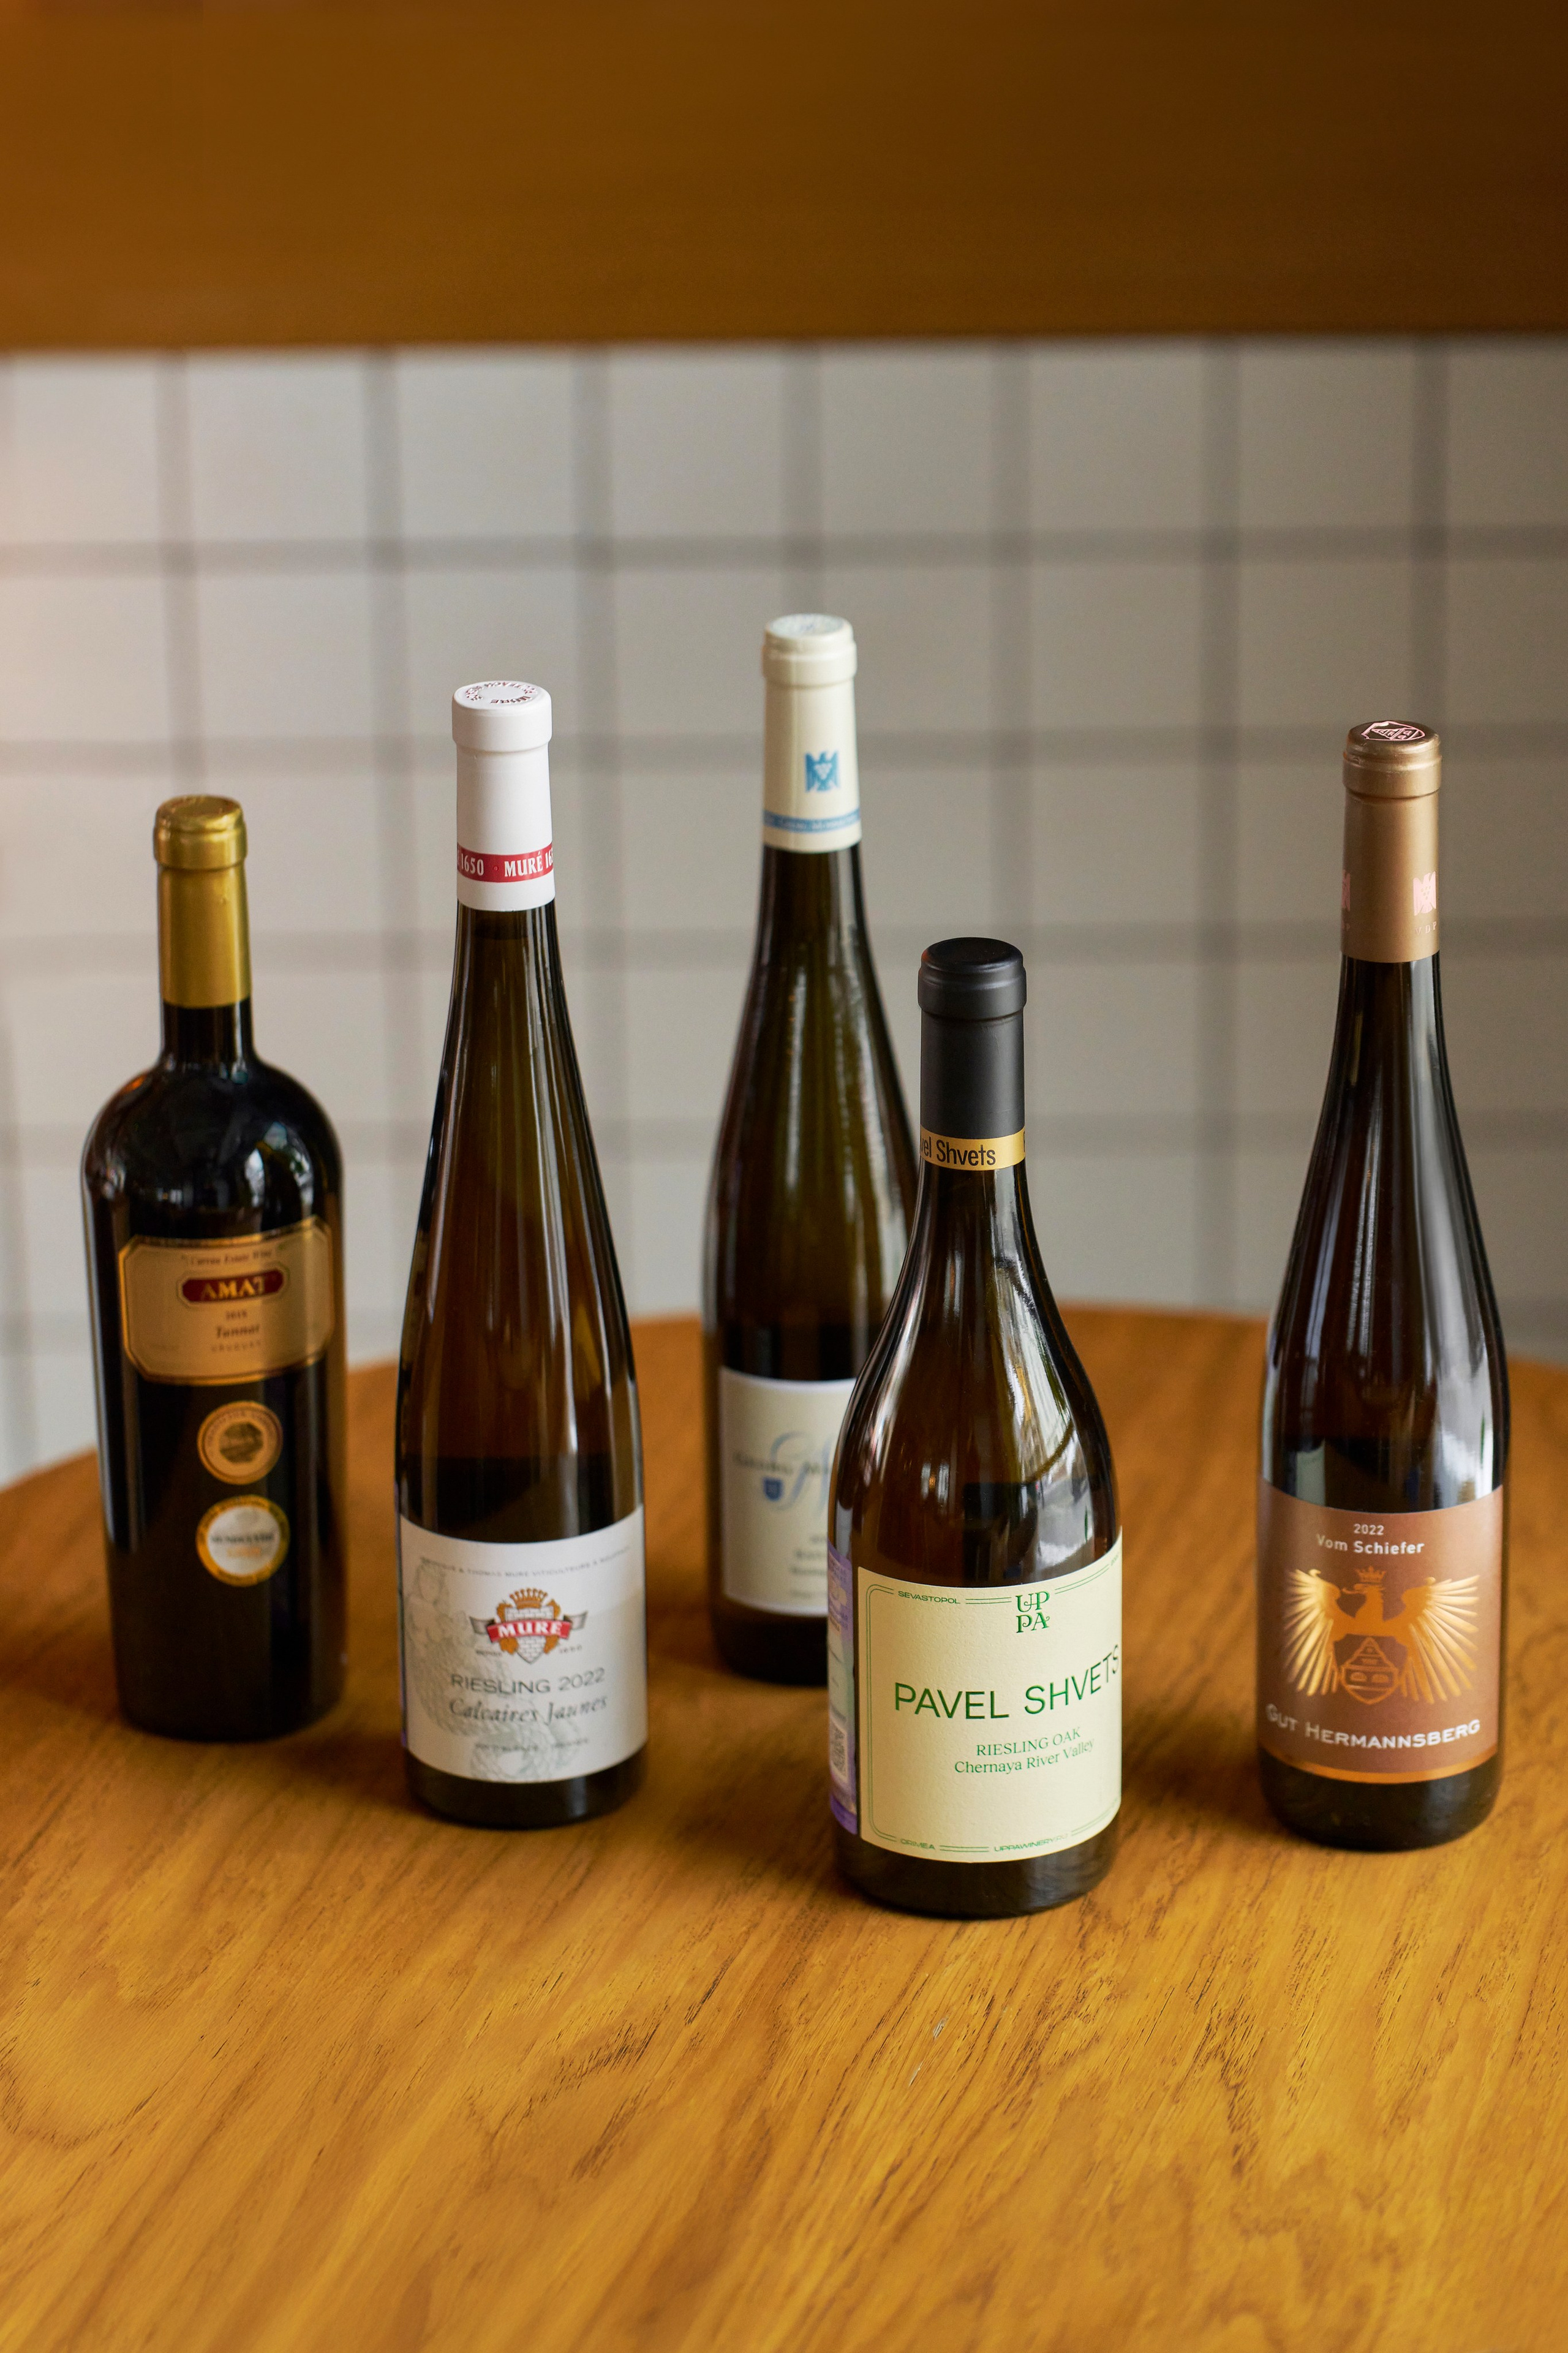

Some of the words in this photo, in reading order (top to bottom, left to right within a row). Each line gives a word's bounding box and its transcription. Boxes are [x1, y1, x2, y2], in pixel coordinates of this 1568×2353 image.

[461, 853, 484, 875] 1650
[504, 851, 543, 877] MURÉ
[936, 1139, 995, 1166] Shvets
[201, 1276, 264, 1299] AMAT
[1354, 1524, 1384, 1536] 2022
[1316, 1534, 1348, 1551] Vom
[1354, 1541, 1425, 1554] Schiefer
[898, 1590, 961, 1605] SEVASTOPOL
[1015, 1591, 1050, 1612] UP
[1016, 1612, 1050, 1634] PA
[450, 1674, 551, 1694] RIESLING
[558, 1667, 605, 1691] 2022
[894, 1682, 1009, 1720] PAVEL
[1024, 1644, 1119, 1715] SHVETS
[449, 1698, 538, 1722] Calcaires
[544, 1696, 608, 1726] Jaunes
[1266, 1704, 1298, 1731] GUT
[1305, 1719, 1480, 1748] HERMANNSBERG
[976, 1737, 1049, 1756] RIESLING
[1053, 1727, 1080, 1745] OAK
[954, 1761, 1022, 1774] Chernaya
[1027, 1753, 1060, 1769] River
[1063, 1739, 1095, 1759] Valley
